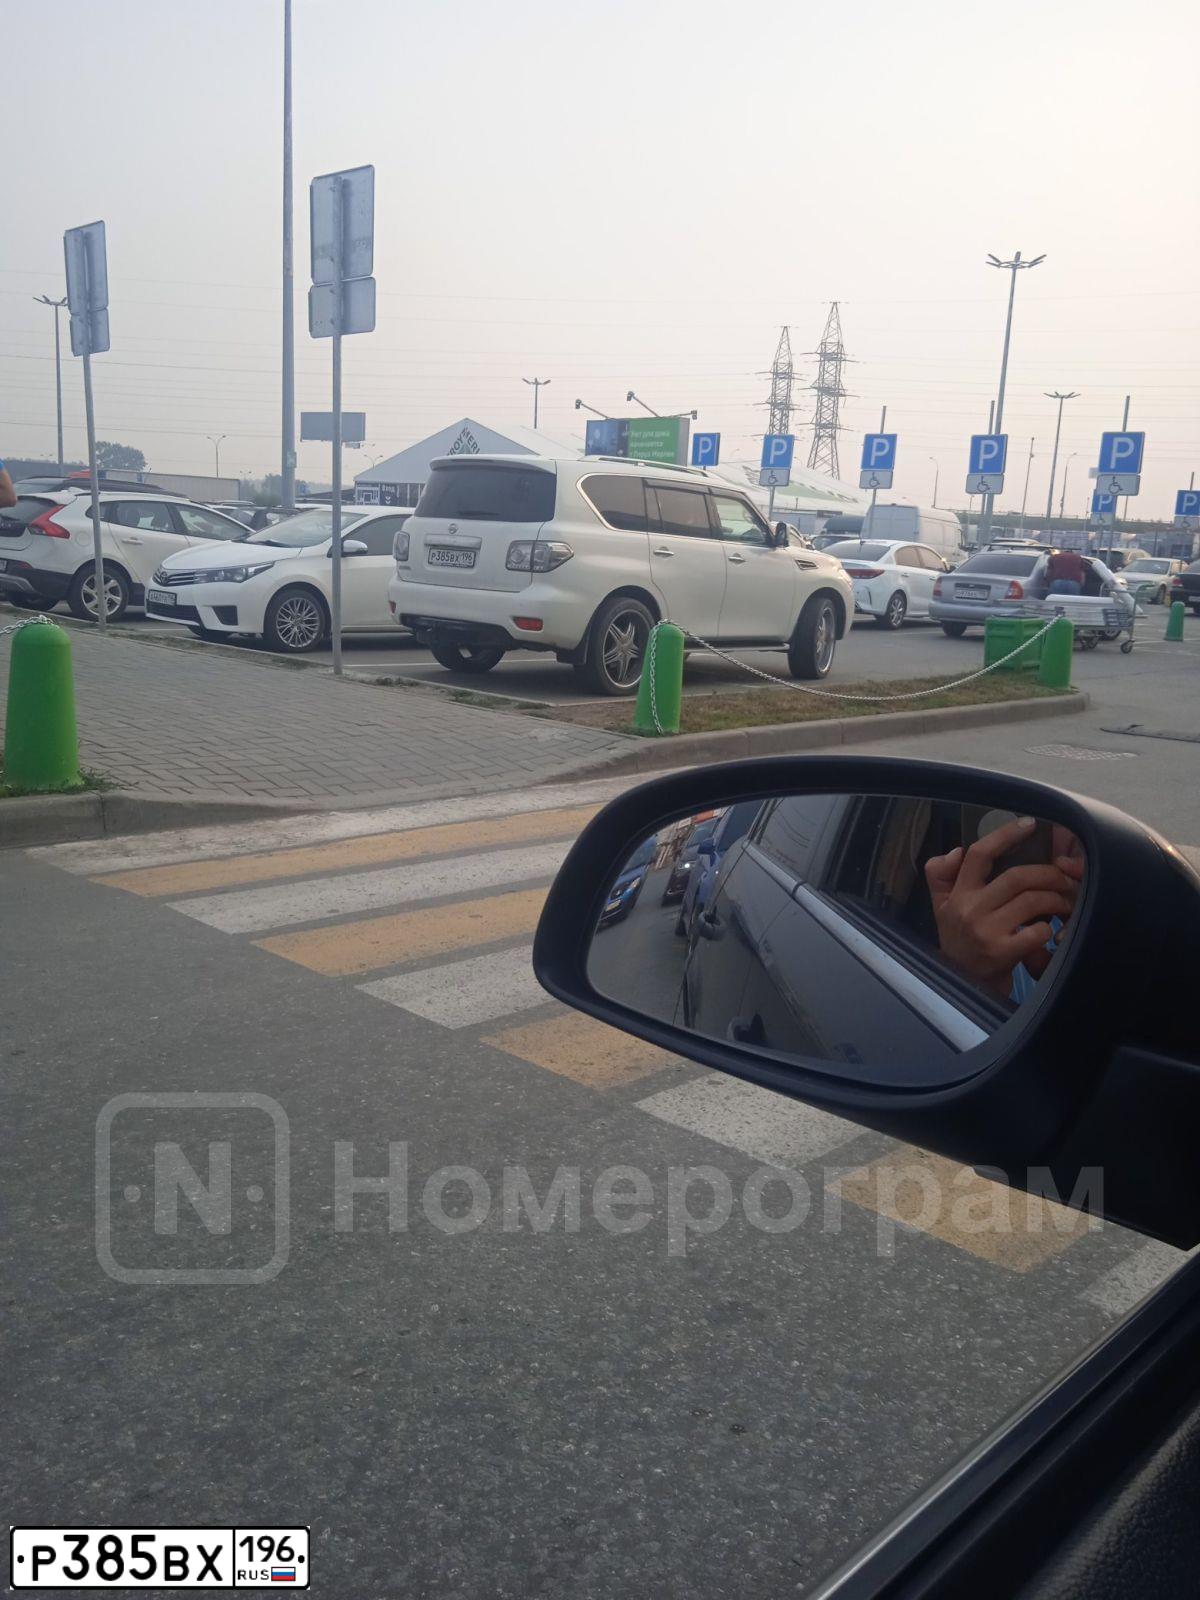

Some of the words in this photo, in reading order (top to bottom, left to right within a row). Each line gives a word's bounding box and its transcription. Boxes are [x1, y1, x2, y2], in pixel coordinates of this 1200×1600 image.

[698, 437, 712, 462] P
[769, 438, 788, 465] P
[869, 438, 890, 466] P
[978, 439, 998, 470] P
[1110, 437, 1135, 469] P
[1182, 493, 1197, 513] P
[461, 552, 473, 562] 196
